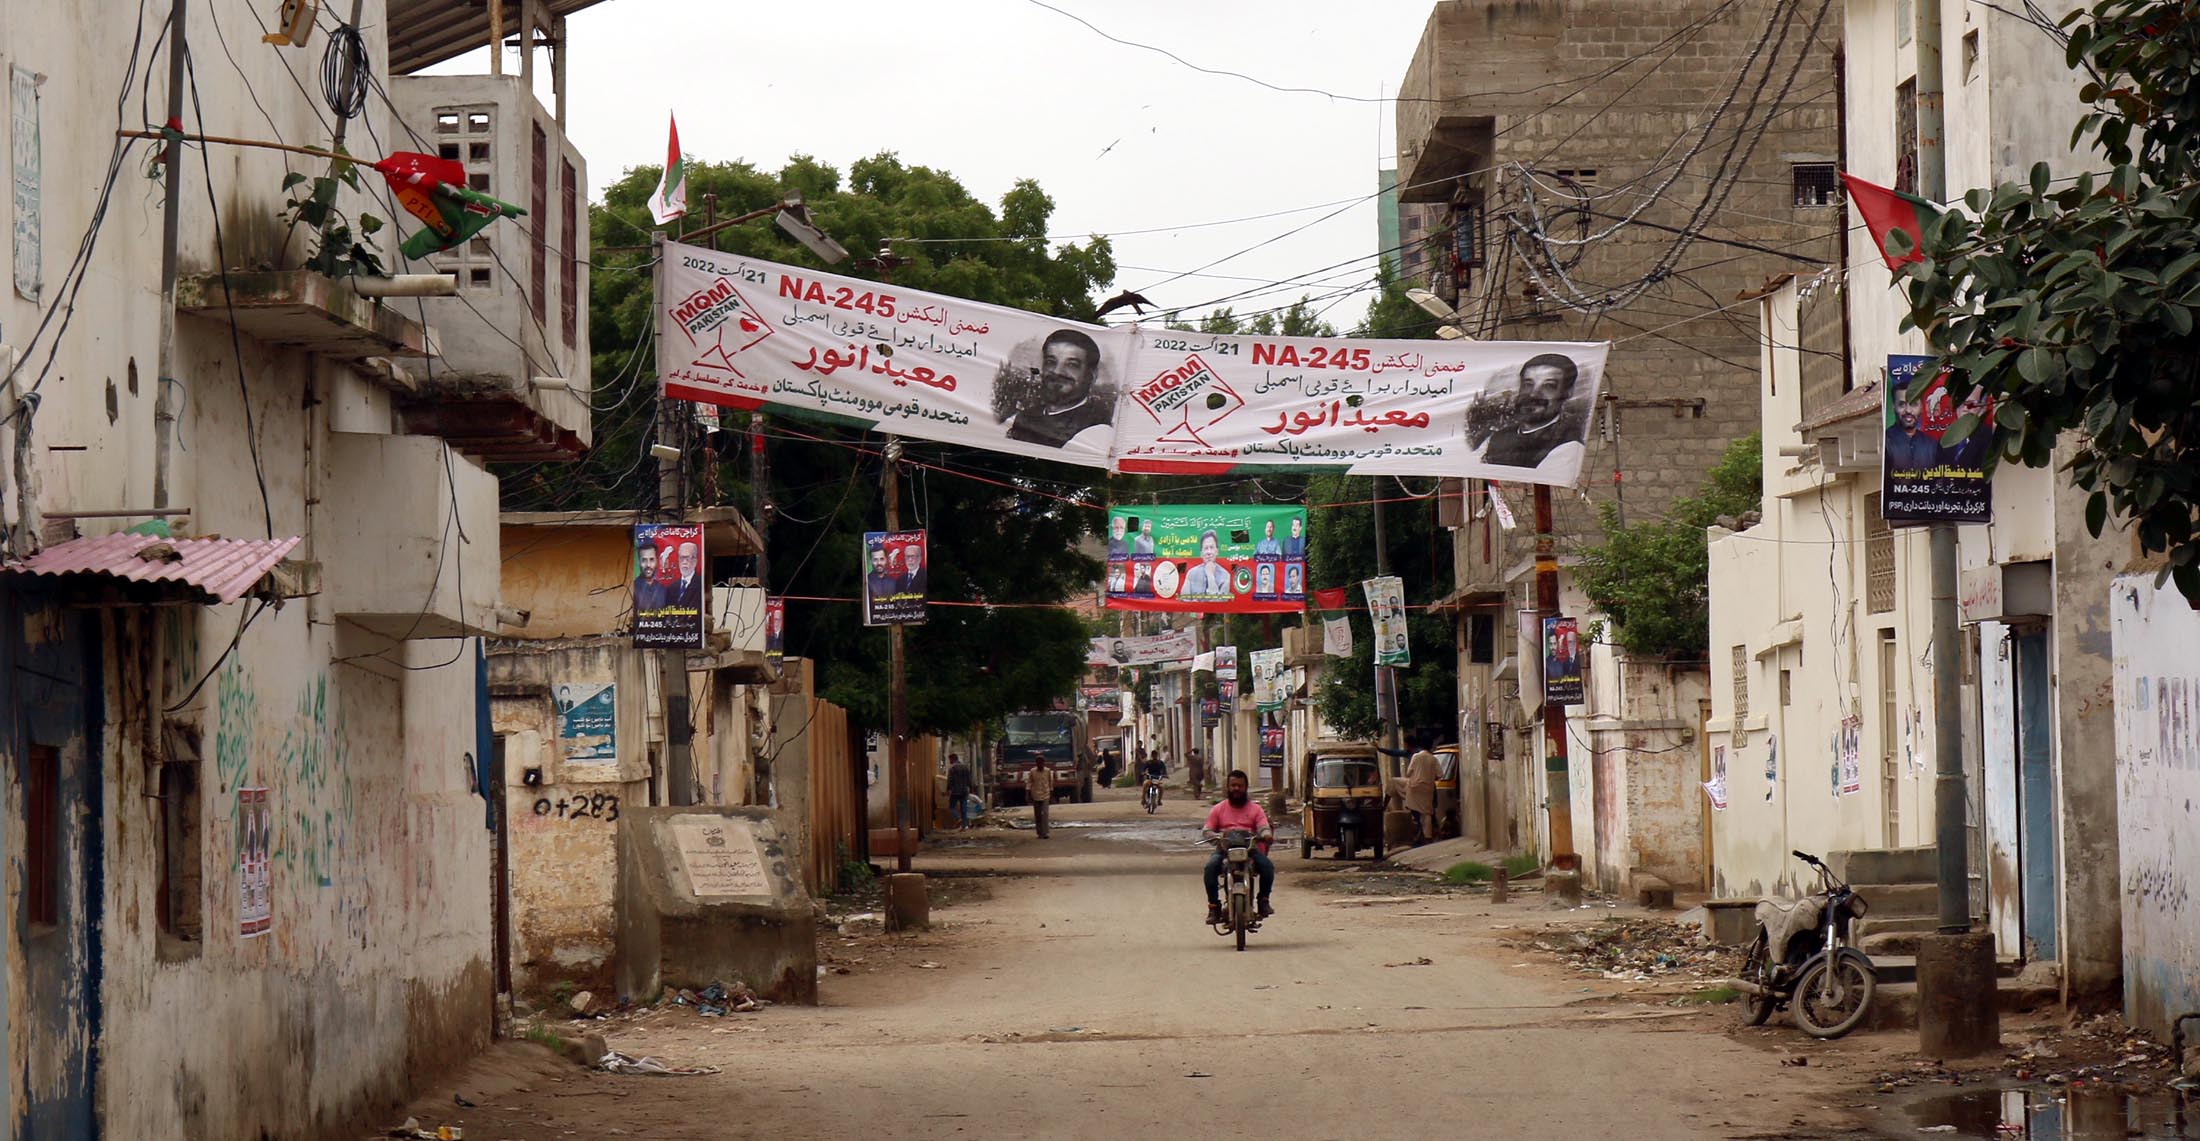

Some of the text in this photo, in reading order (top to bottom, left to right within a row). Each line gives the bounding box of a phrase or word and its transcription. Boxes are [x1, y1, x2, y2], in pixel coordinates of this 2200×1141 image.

[683, 256, 715, 274] 2022
[676, 282, 732, 323] MQM
[779, 274, 990, 336] ضمنی الیکشن NA-245
[689, 299, 740, 335] PAKISTAN
[1154, 339, 1187, 351] 2022
[792, 343, 870, 376] انور
[1251, 343, 1466, 378] ضمنی الیکشن NA-245
[772, 377, 829, 407] پاکستان
[1138, 359, 1202, 403] MQM
[1154, 373, 1211, 413] PAKISTAN
[882, 398, 921, 417] قومی
[921, 407, 970, 426] متحدہ
[1260, 399, 1342, 436] انور
[1243, 438, 1300, 462] پاکستان
[1355, 443, 1393, 459] قومی
[1394, 443, 1443, 457] متحدہ
[1893, 485, 1930, 494] NA-245
[680, 527, 698, 539] کراچی
